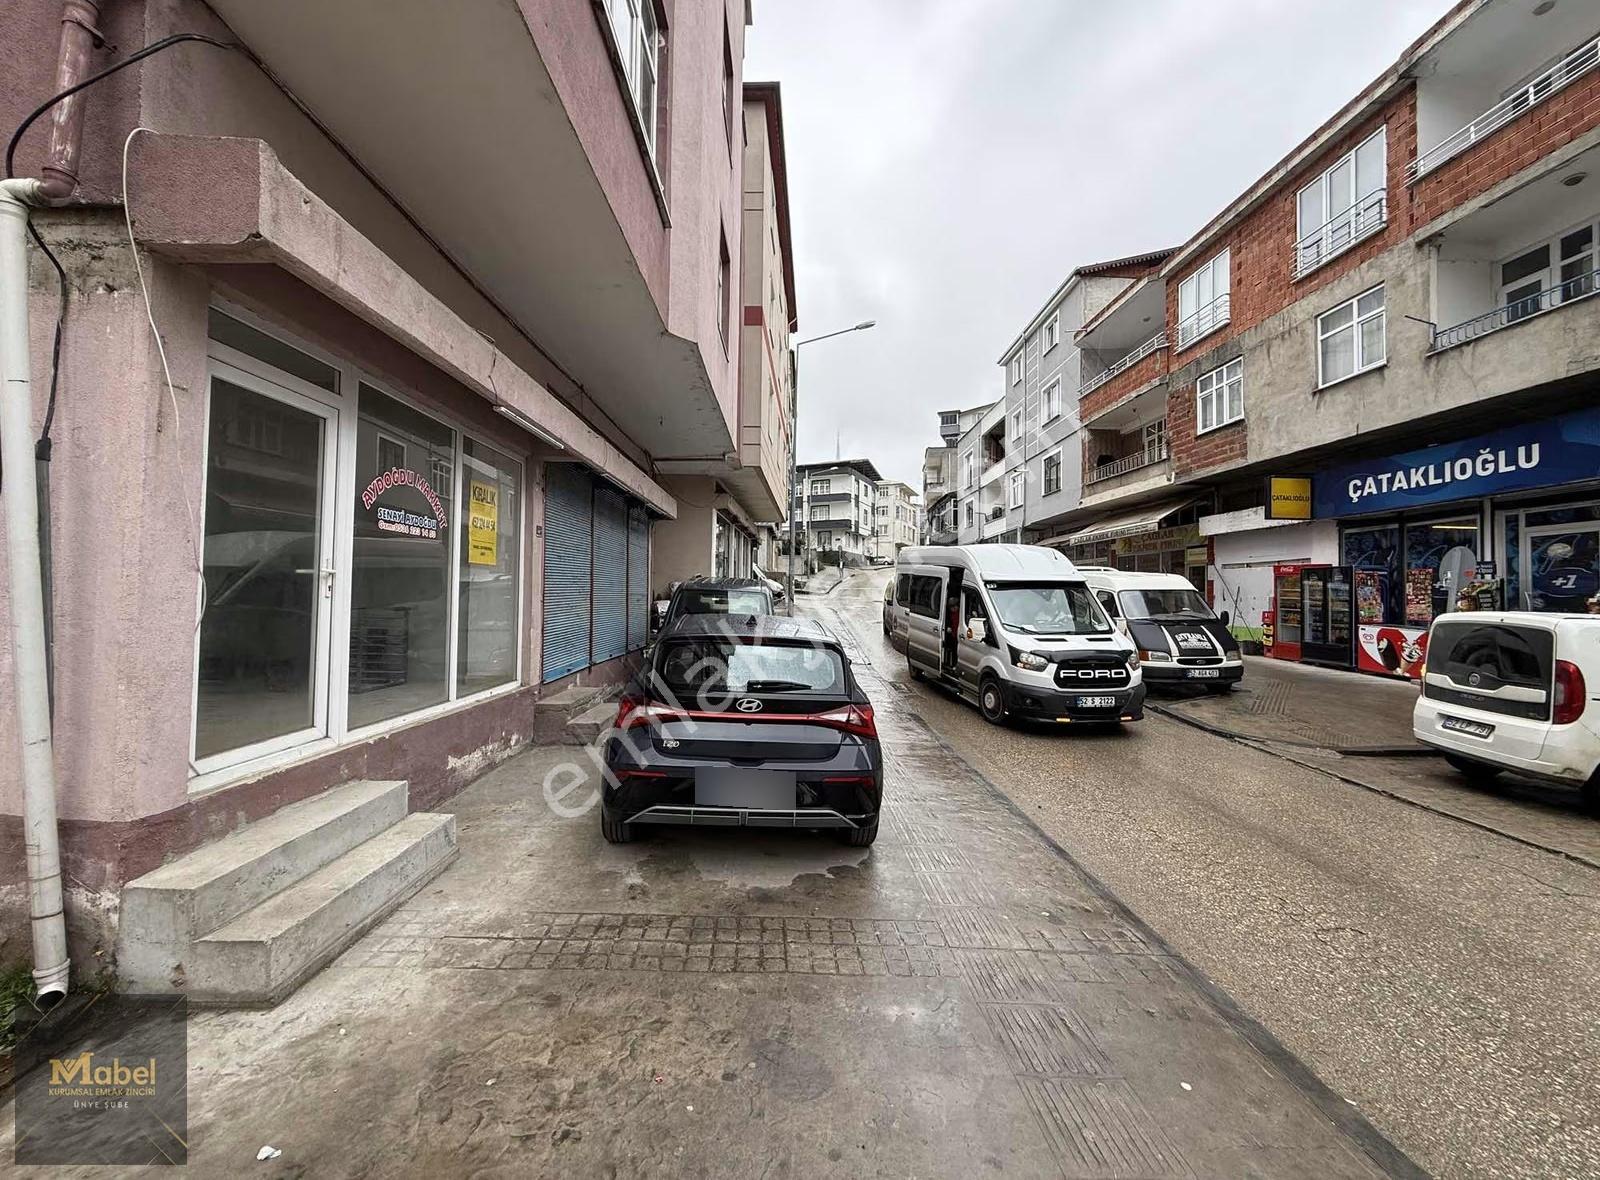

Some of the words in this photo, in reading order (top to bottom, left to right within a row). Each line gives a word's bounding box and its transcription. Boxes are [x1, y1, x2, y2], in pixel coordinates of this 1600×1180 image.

[1348, 443, 1540, 503] ÇATAKLIOĞLU
[362, 467, 415, 510] AYDOĞDU
[415, 474, 448, 528] MARKET
[405, 513, 437, 529] AYDOĞDU
[1060, 669, 1126, 678] FORD
